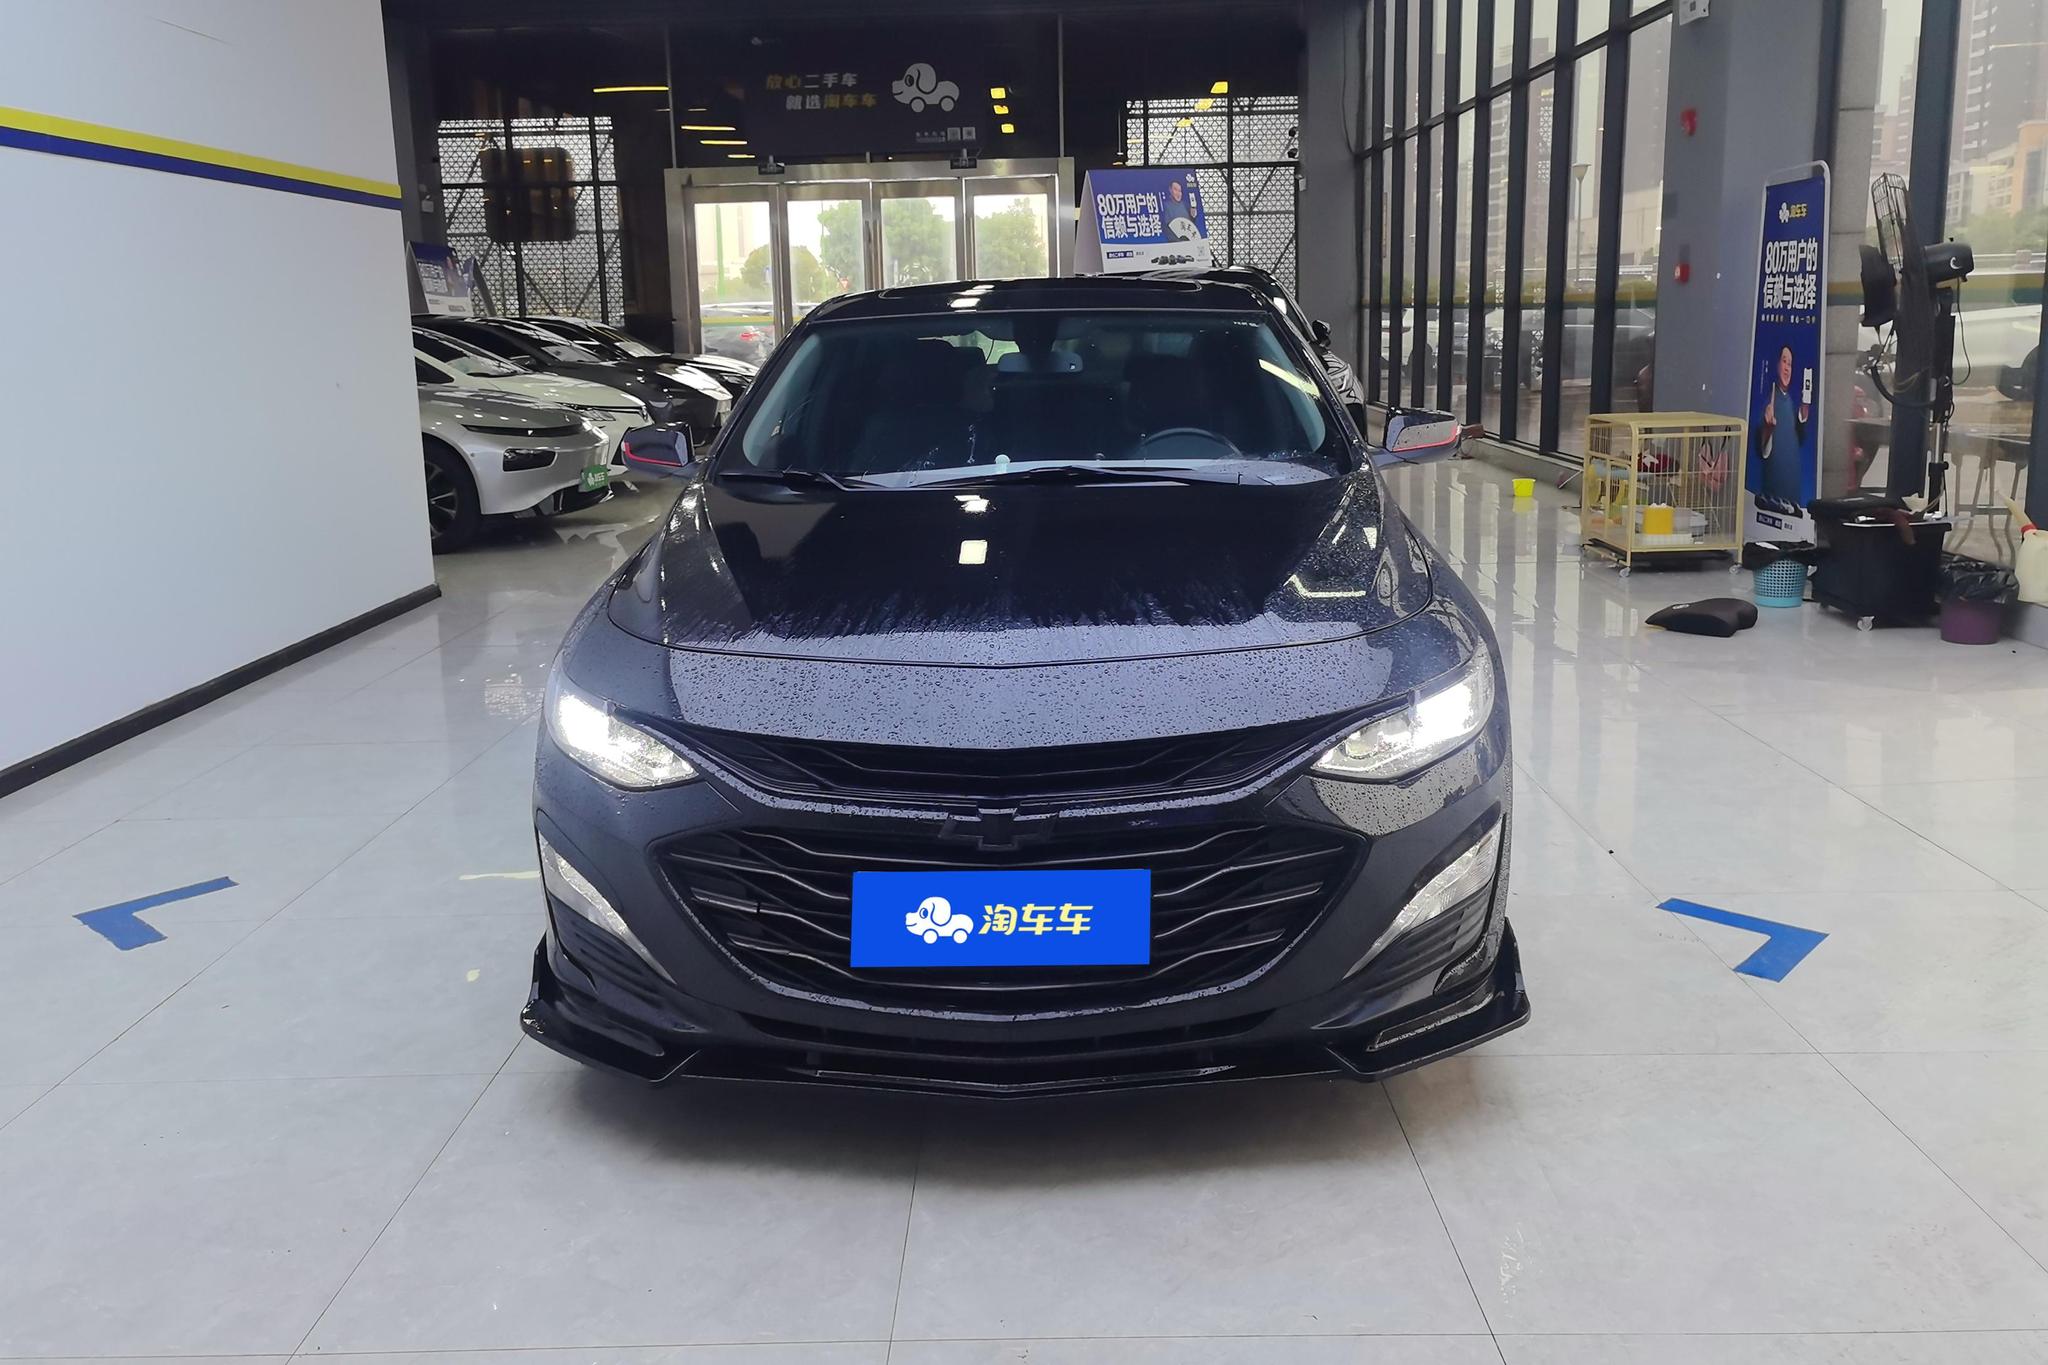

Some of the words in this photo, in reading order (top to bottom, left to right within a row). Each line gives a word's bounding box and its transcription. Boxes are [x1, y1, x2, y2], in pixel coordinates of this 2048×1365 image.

[1096, 192, 1159, 216] 80万用户的
[1101, 214, 1162, 239] 信赖与选择
[1765, 237, 1818, 274] 80万用户的
[1763, 273, 1817, 310] 信赖与选择
